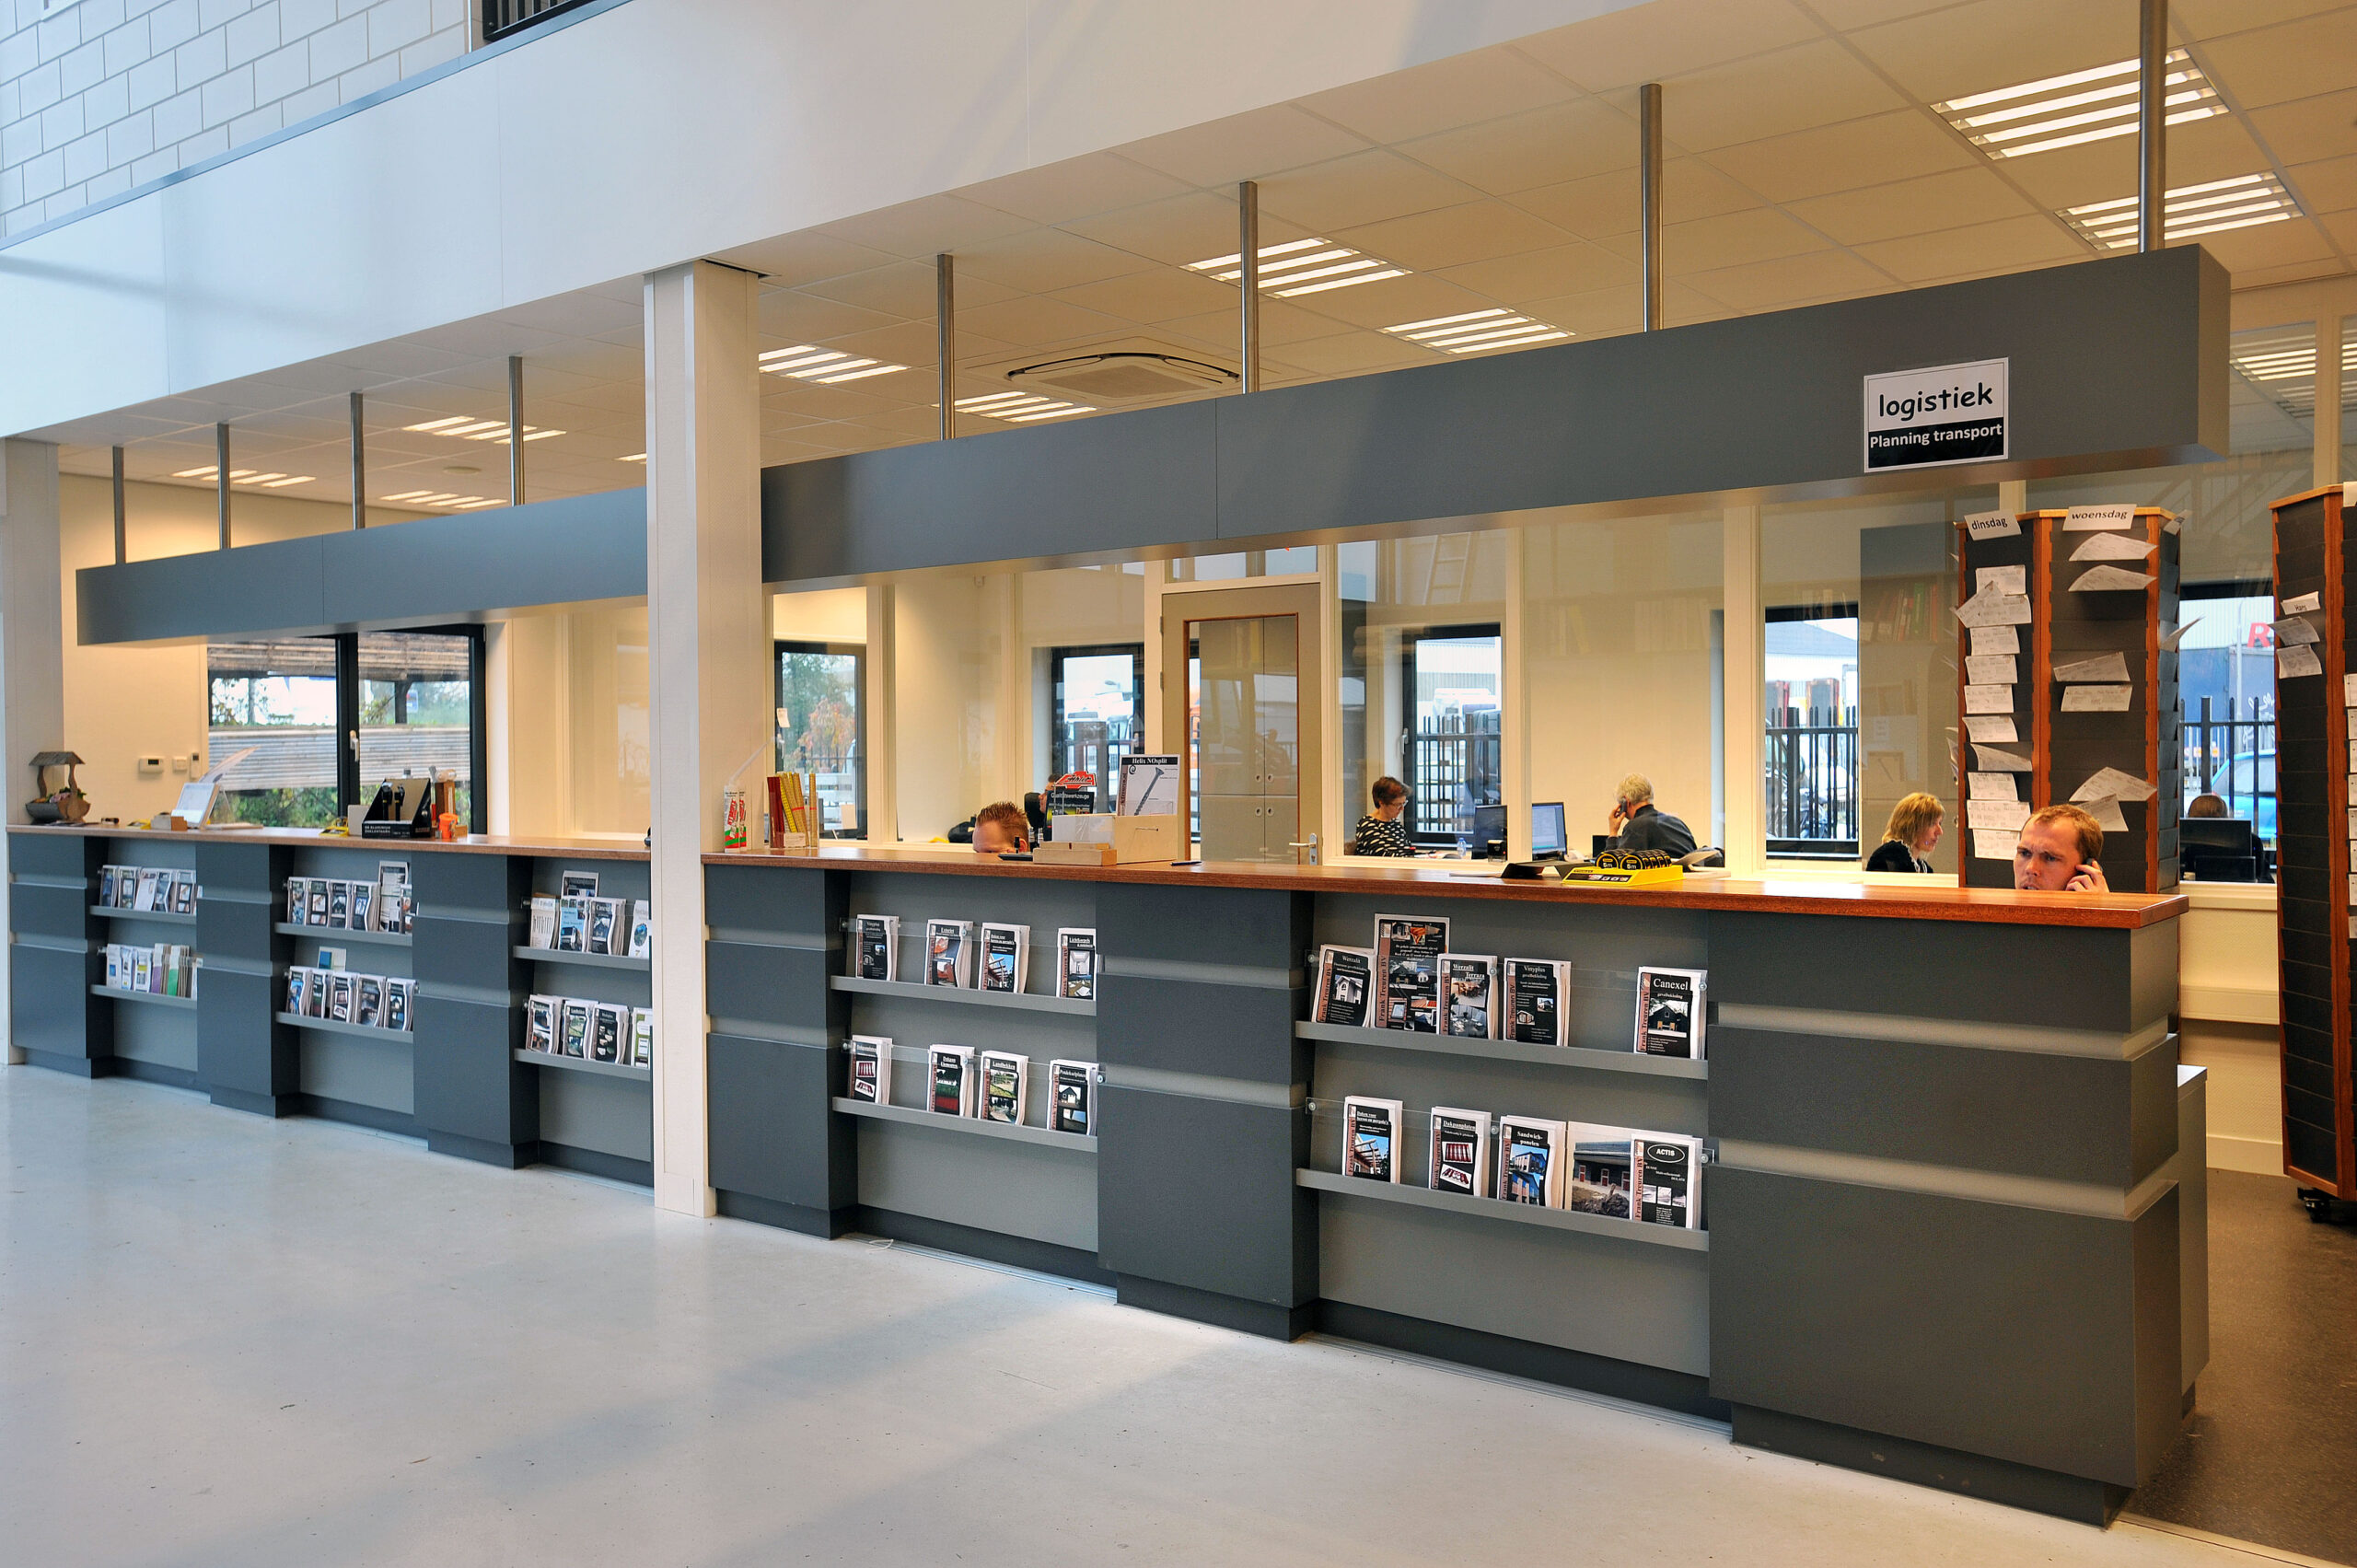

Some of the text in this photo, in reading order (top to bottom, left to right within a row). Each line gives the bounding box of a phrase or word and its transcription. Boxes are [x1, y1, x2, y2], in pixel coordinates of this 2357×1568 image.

[1879, 381, 1993, 422] logistiek
[1870, 423, 2003, 448] Planning transport
[2072, 509, 2128, 520] woensdag
[1971, 517, 2008, 530] dinsdag
[1341, 955, 1361, 964] Werzalit
[1381, 956, 1387, 967] BV
[1524, 965, 1546, 973] Vinyplus
[1445, 975, 1450, 984] BV
[1653, 978, 1689, 991] Canexel
[1510, 984, 1515, 993] BV
[1643, 991, 1649, 1001] BV
[1516, 1131, 1543, 1140] Sandwich-
[1655, 1148, 1676, 1156] ACTIS
[1637, 1157, 1643, 1167] BV
